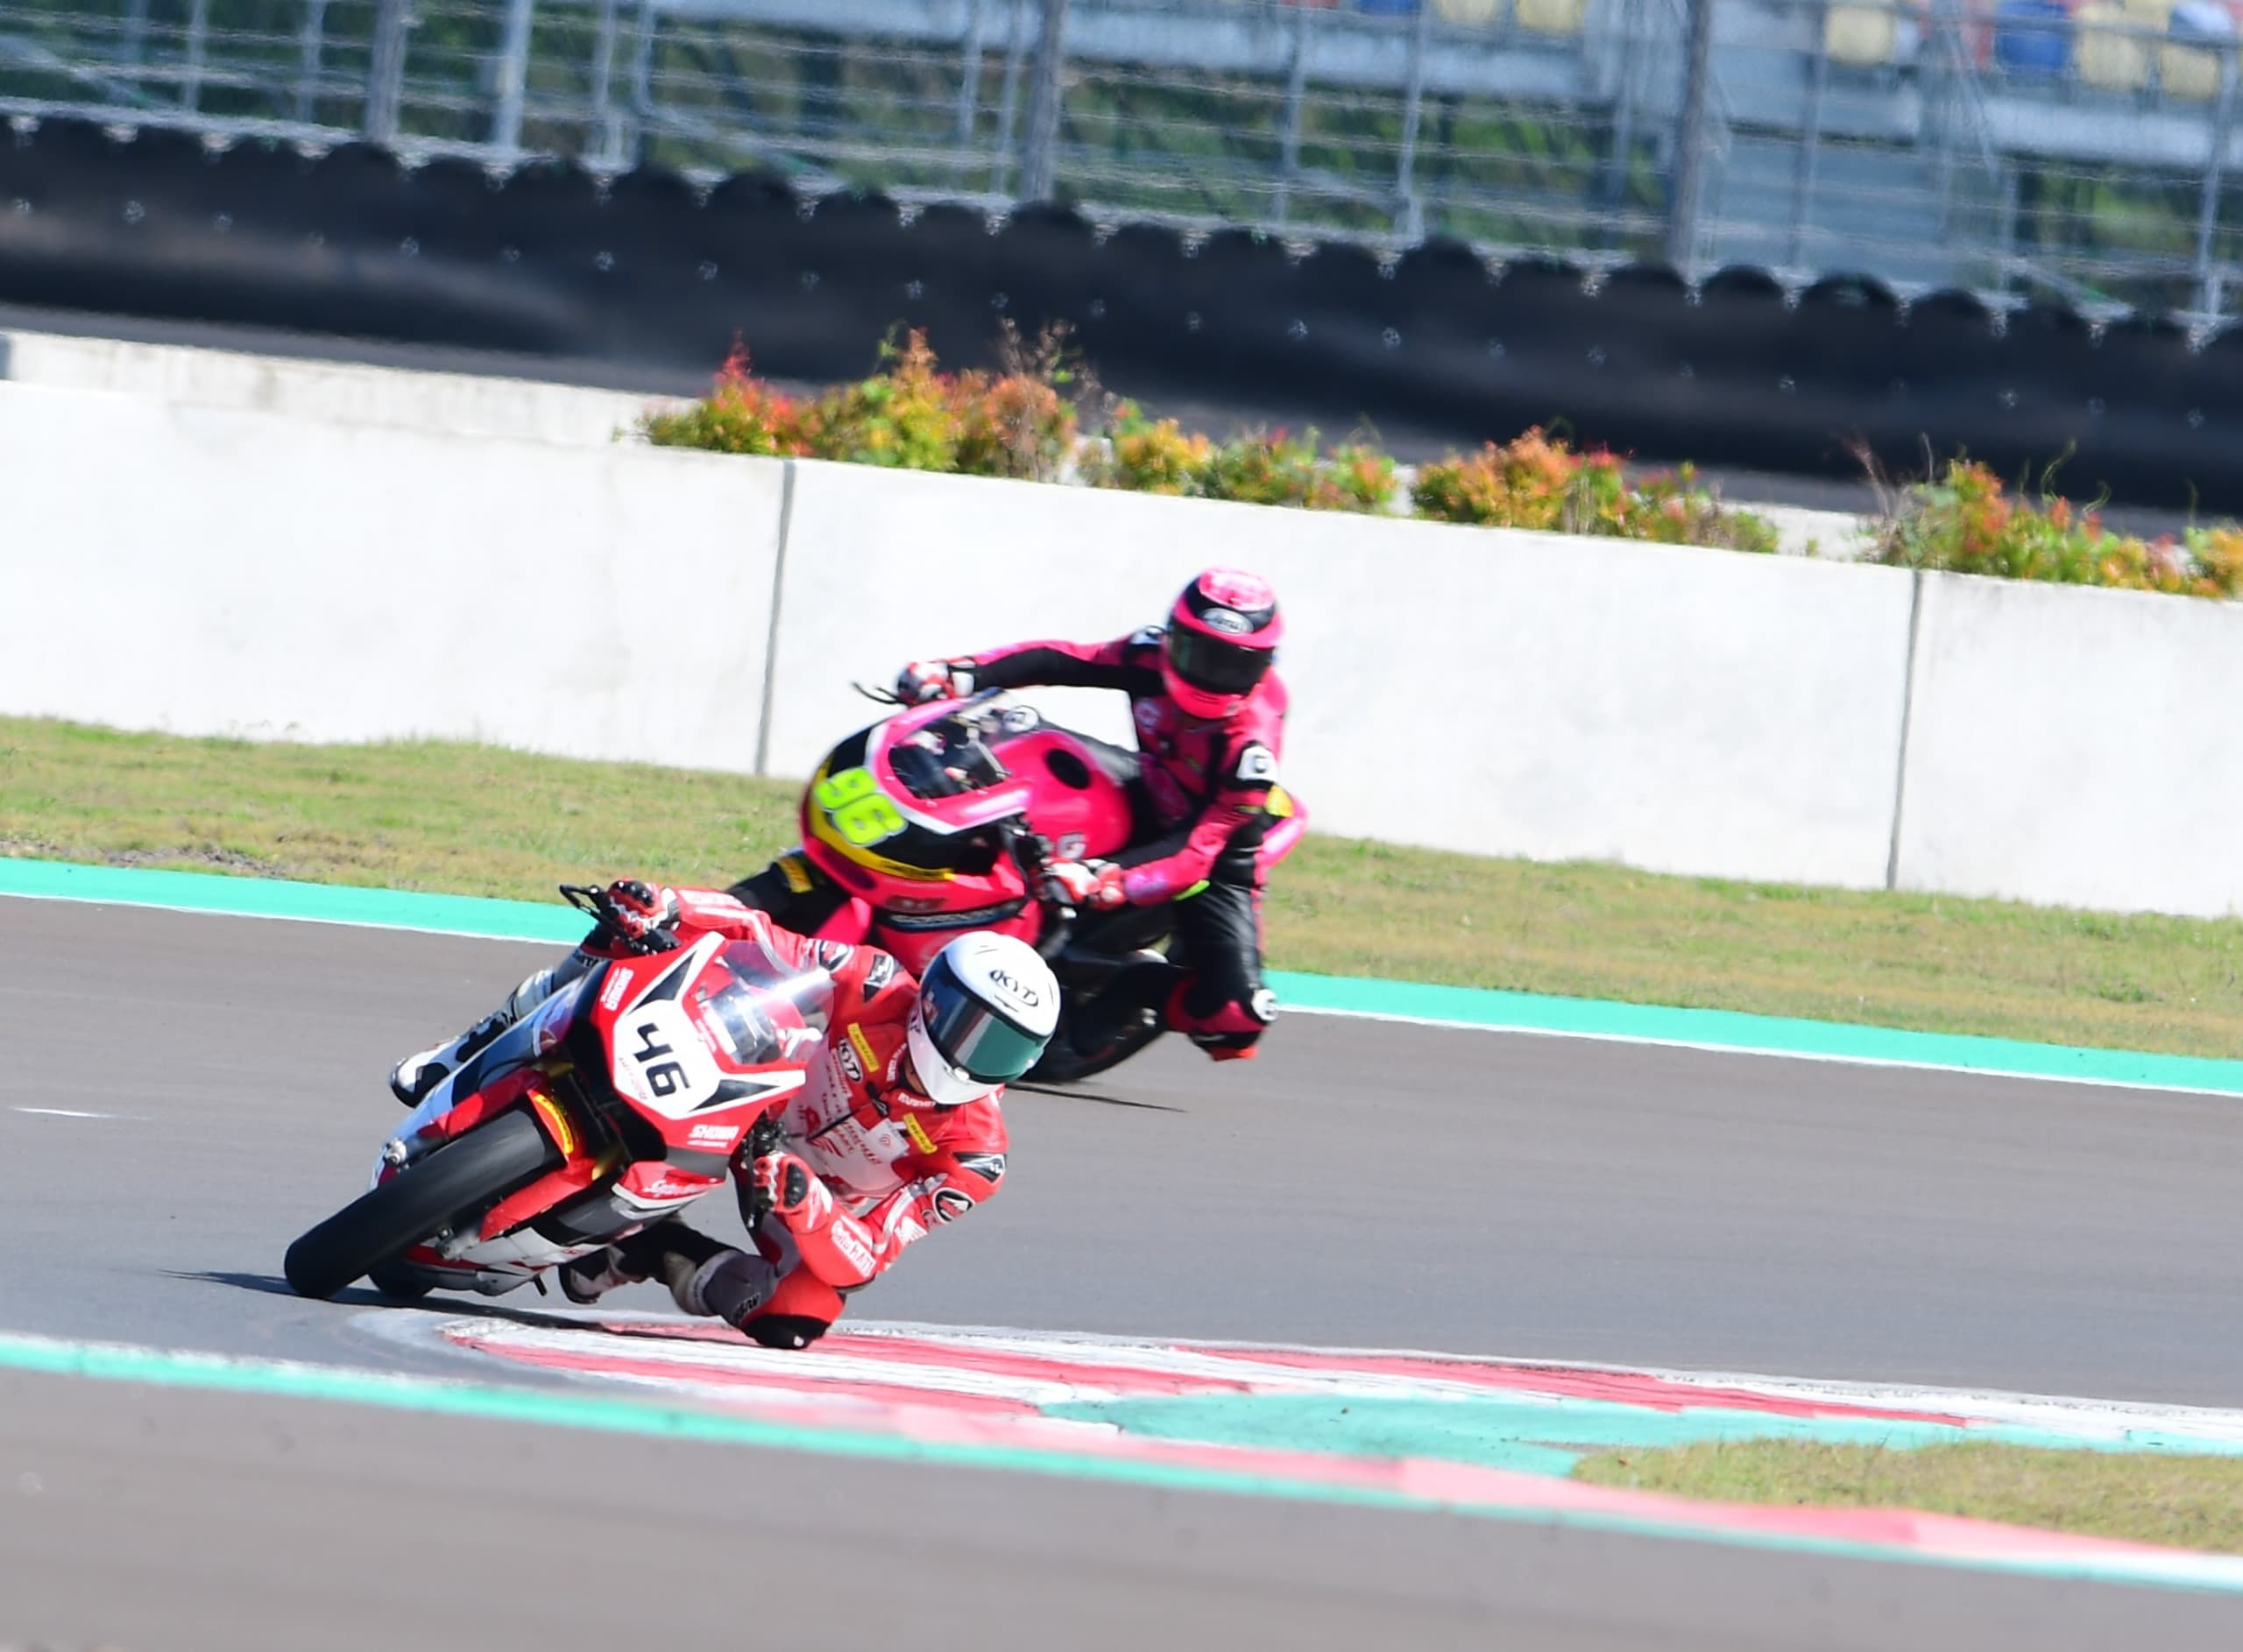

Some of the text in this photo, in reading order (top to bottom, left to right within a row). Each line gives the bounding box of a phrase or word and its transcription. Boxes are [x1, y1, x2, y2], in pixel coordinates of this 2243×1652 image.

[993, 970, 1037, 1005] KYT
[634, 1023, 690, 1097] 46
[839, 1039, 861, 1079] KYT
